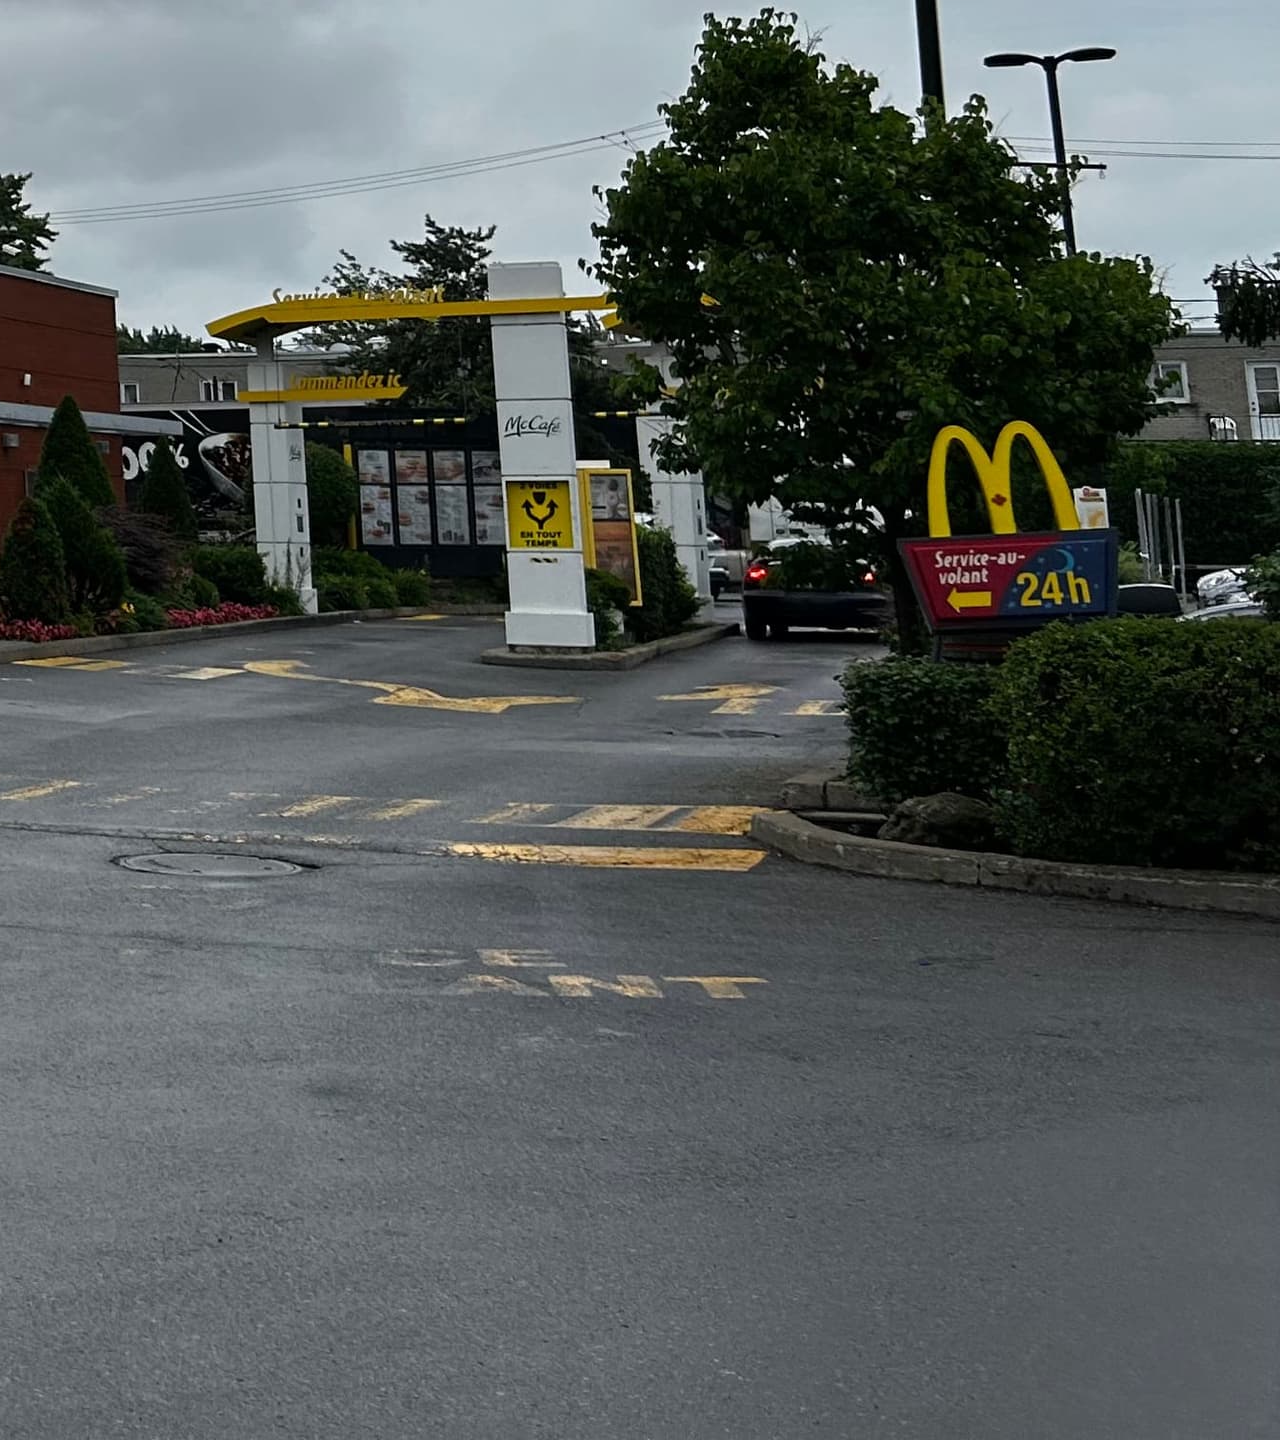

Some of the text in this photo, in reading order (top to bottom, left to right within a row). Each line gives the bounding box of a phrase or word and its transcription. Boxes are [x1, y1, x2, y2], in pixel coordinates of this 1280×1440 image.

[525, 539, 559, 547] TEMPS
[935, 549, 1026, 569] Service-au-
[938, 566, 990, 586] volant
[1016, 571, 1091, 606] 24h
